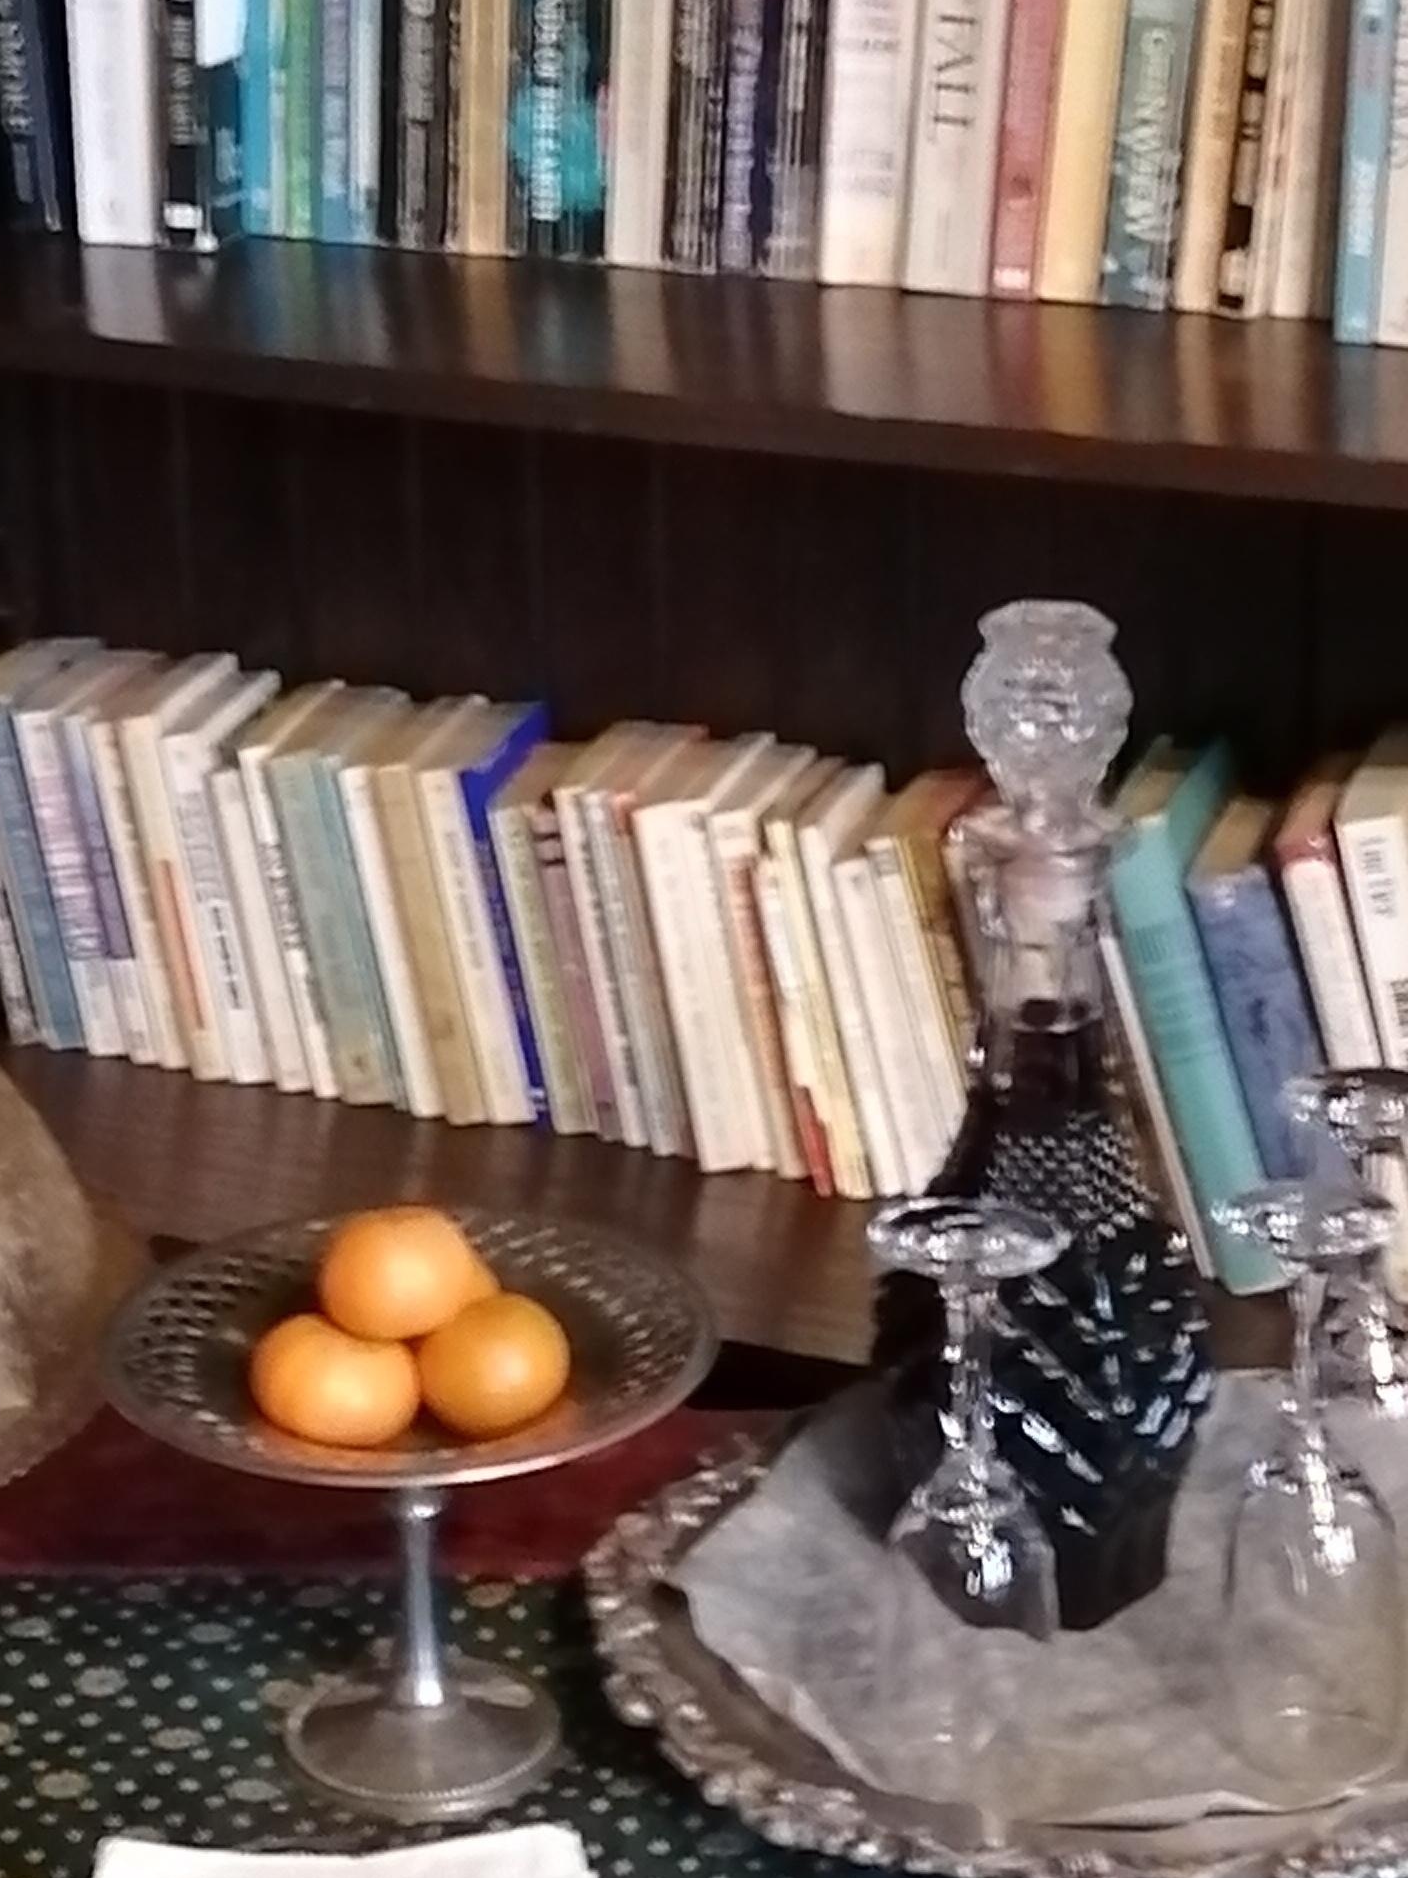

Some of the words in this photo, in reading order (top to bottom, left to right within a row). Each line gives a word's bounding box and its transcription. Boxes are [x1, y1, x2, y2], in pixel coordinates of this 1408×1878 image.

[532, 46, 566, 79] OF
[531, 86, 564, 136] THE
[530, 140, 563, 221] EARTH
